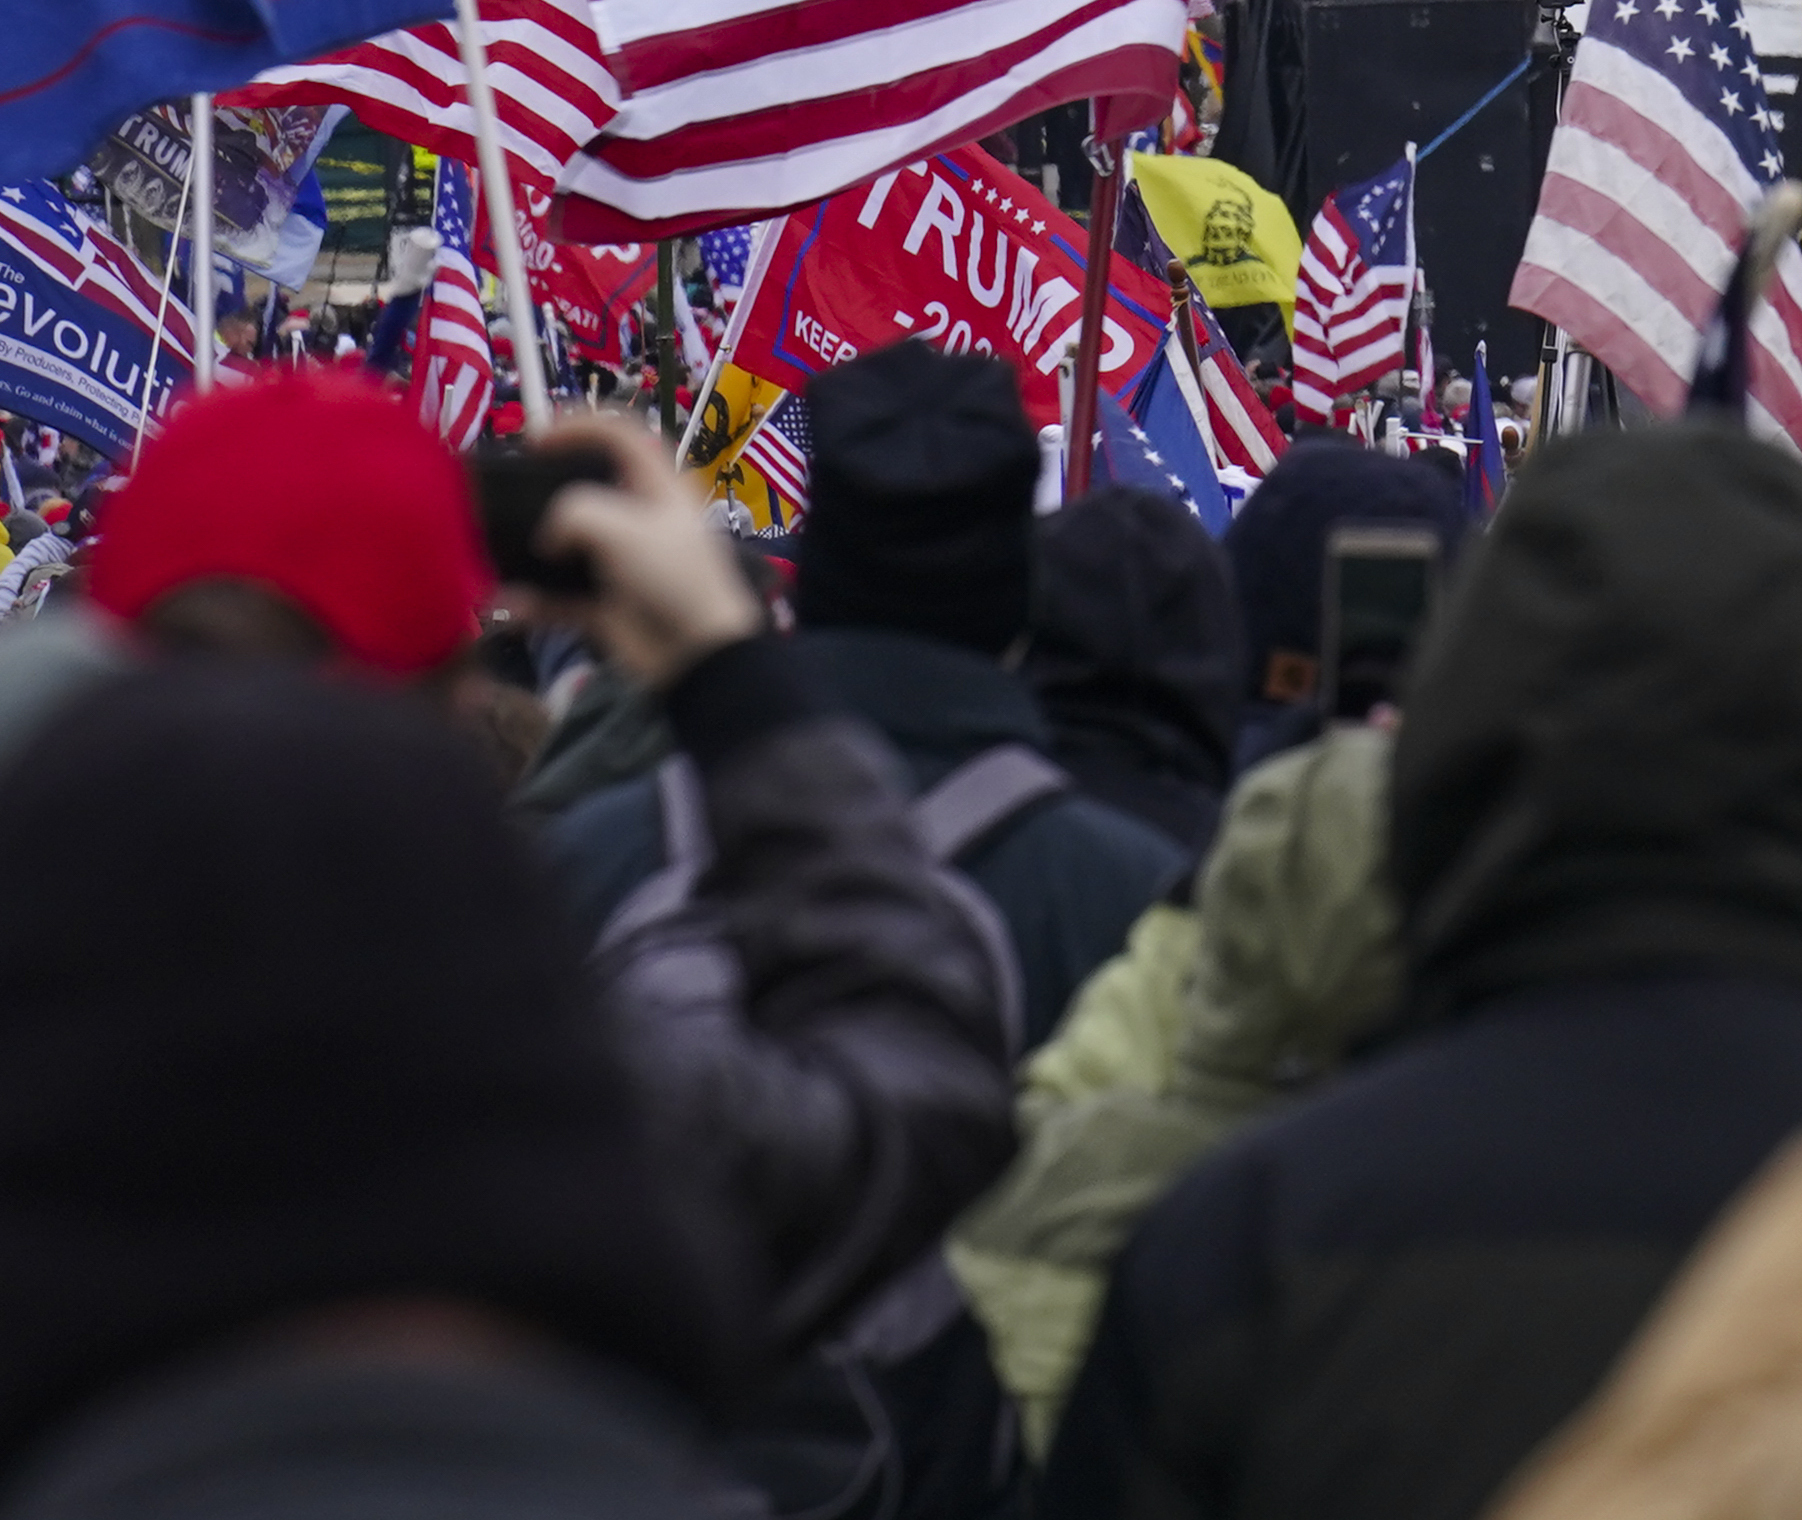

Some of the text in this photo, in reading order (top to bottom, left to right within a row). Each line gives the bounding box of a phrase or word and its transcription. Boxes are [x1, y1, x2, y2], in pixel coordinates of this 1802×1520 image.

[117, 112, 198, 184] TRUM
[856, 158, 1136, 377] TRUMP
[32, 390, 54, 407] and
[55, 399, 84, 422] claim
[78, 376, 131, 420] Protecting
